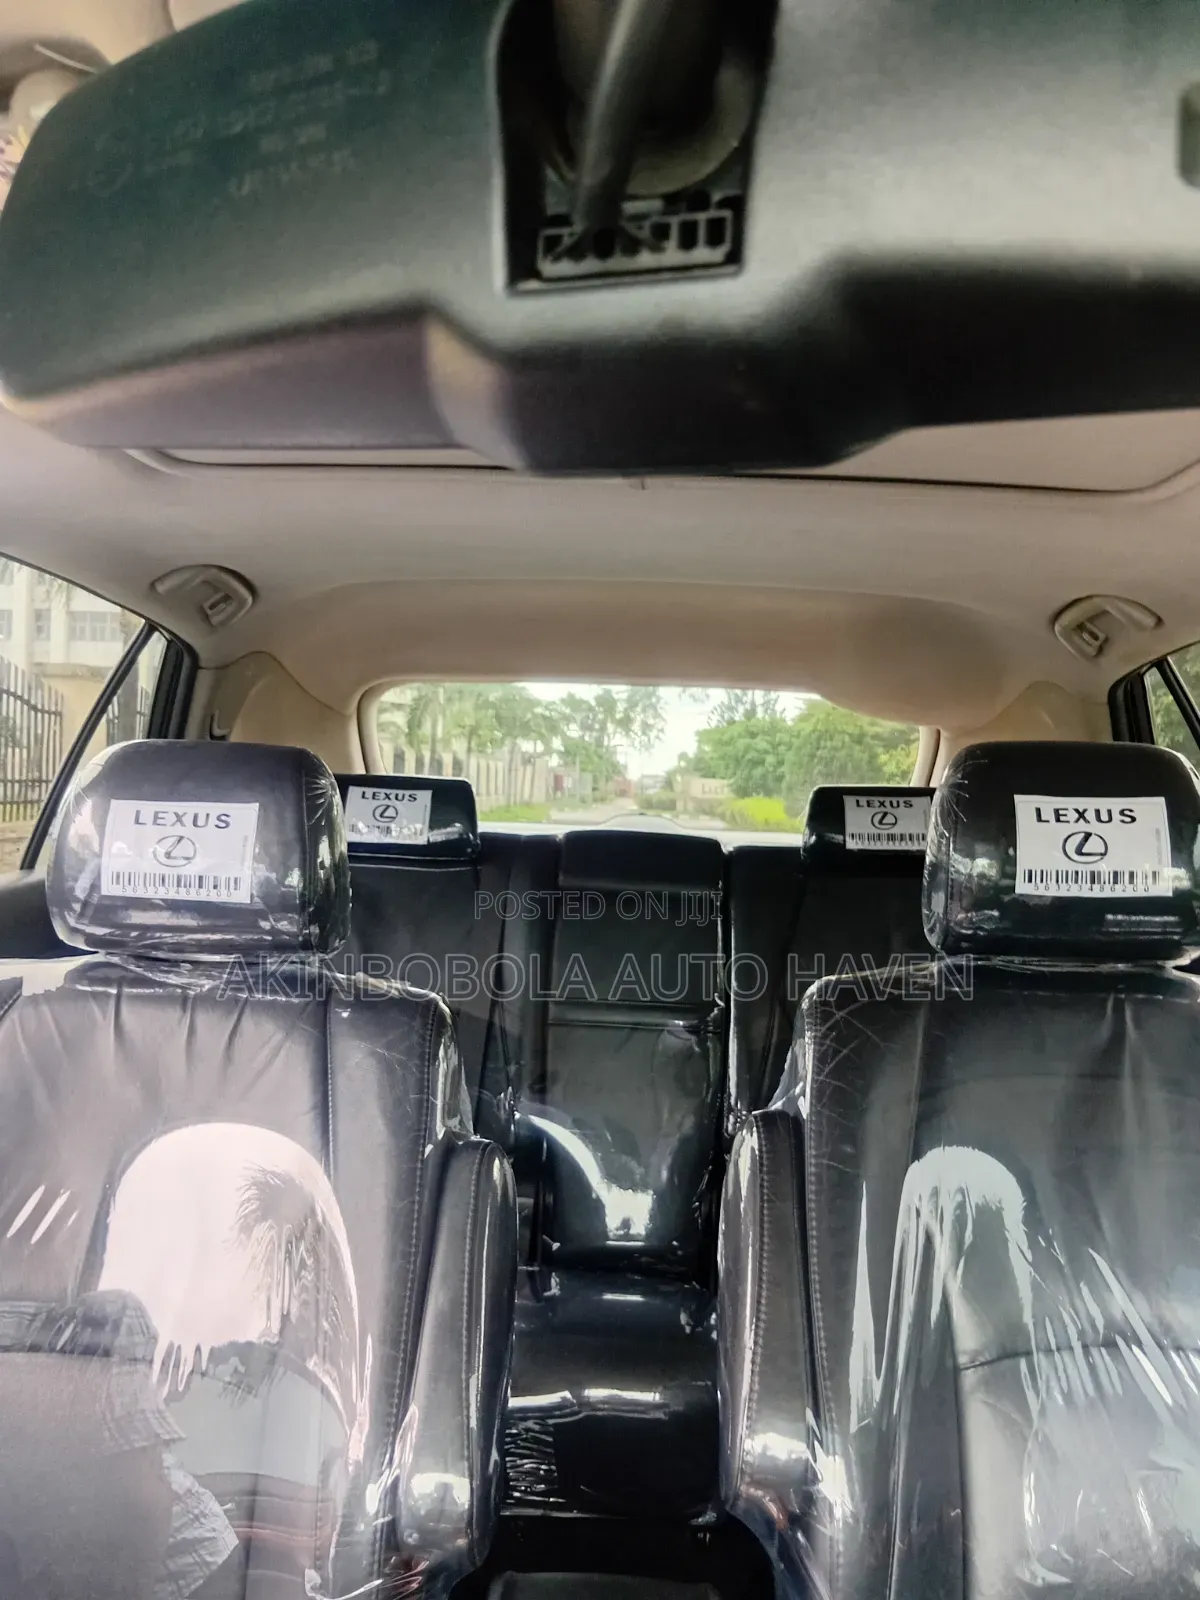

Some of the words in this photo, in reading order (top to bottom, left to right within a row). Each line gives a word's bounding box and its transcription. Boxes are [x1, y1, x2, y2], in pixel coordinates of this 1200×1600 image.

[361, 791, 418, 803] LEXUS
[855, 799, 914, 809] LEXUS
[134, 809, 233, 830] LEXUS
[1035, 807, 1137, 824] LEXUS
